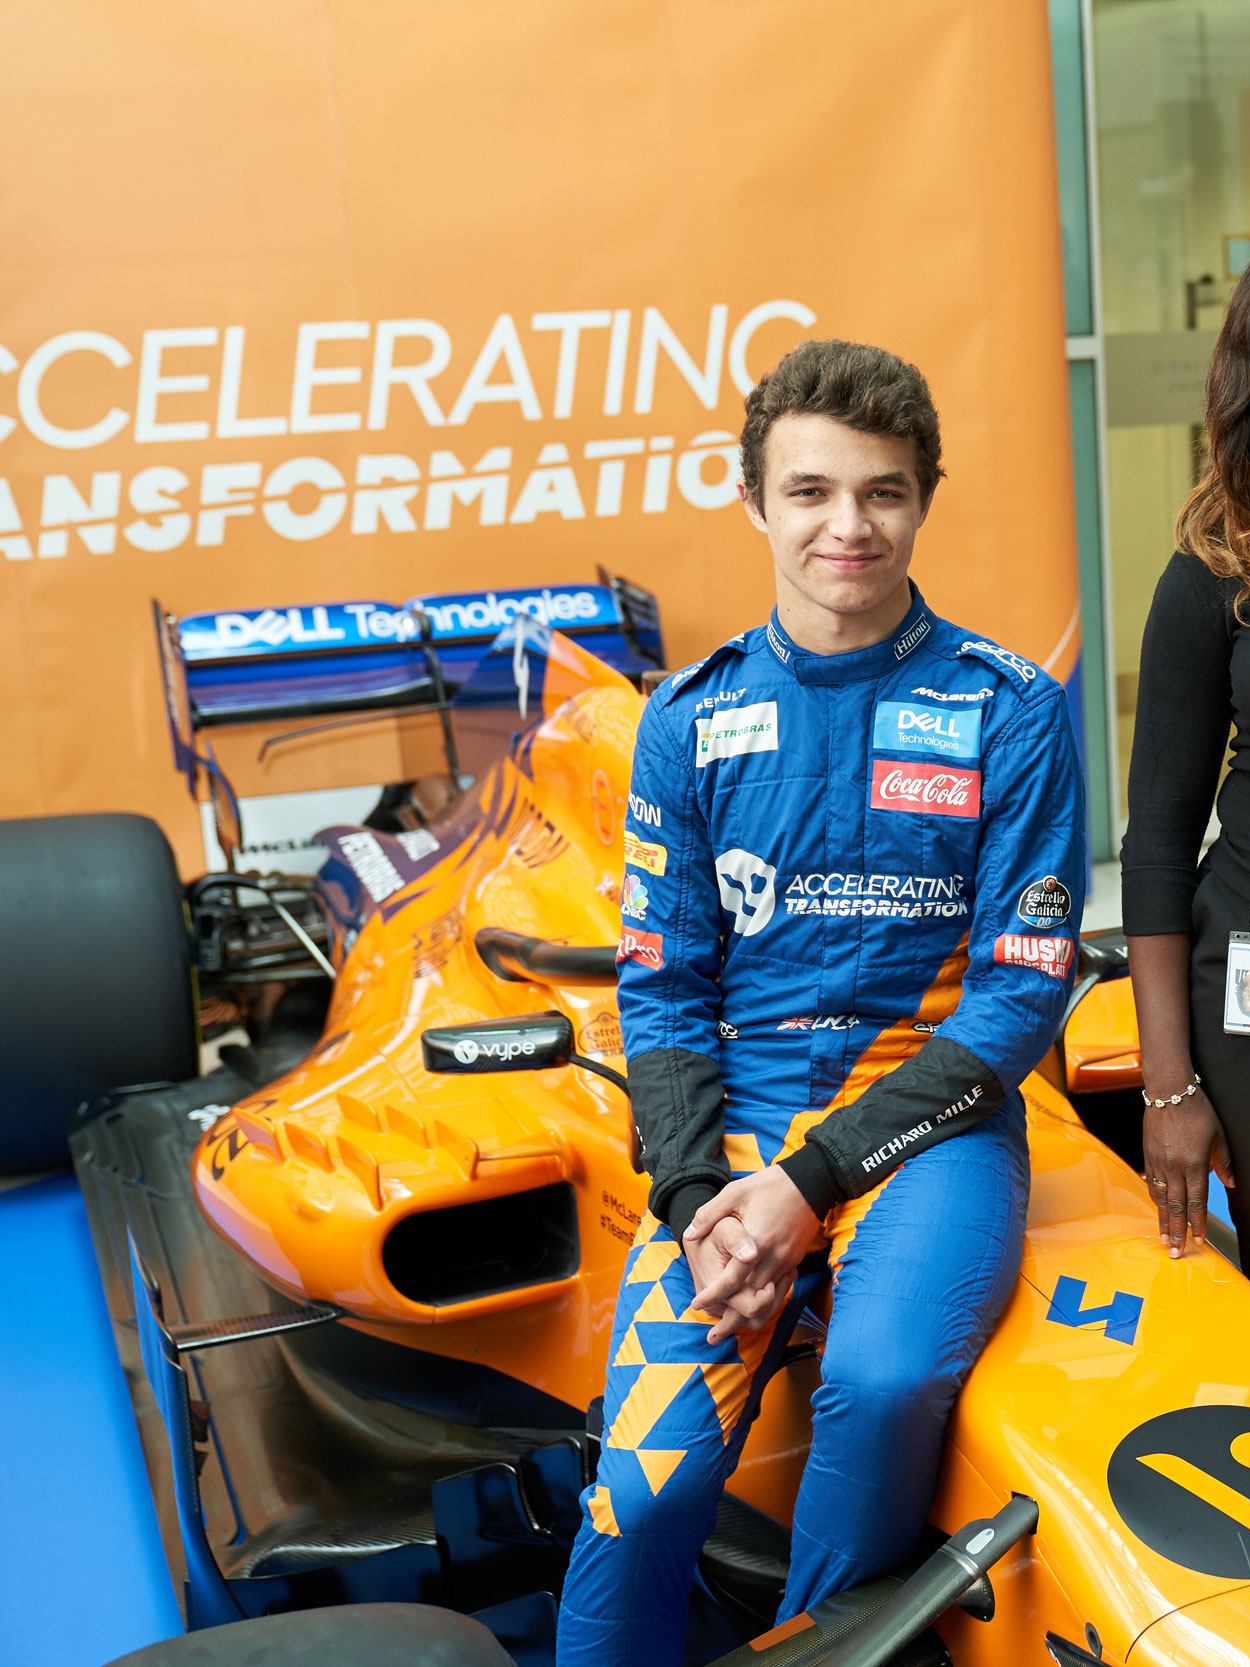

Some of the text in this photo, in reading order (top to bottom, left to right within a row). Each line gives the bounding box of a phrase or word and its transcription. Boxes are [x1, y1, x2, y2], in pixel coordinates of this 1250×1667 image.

[0, 300, 817, 449] CELERATIN
[215, 608, 345, 646] DELL
[897, 621, 927, 654] Hilton
[960, 641, 1037, 682] sparco
[911, 687, 994, 701] McLaren
[897, 709, 960, 738] DELL
[897, 732, 959, 750] Technologies
[880, 769, 973, 806] Coca-Cola
[785, 872, 964, 899] ACCELERATING
[1026, 890, 1066, 904] Estrella
[621, 903, 648, 921] CNBC
[784, 896, 968, 918] TRANSFORMATION
[1026, 902, 1063, 917] Galicia
[1004, 936, 1071, 964] HUSKI
[482, 1041, 536, 1061] vype
[861, 1120, 933, 1174] RICHARD
[936, 1084, 985, 1126] MILLE
